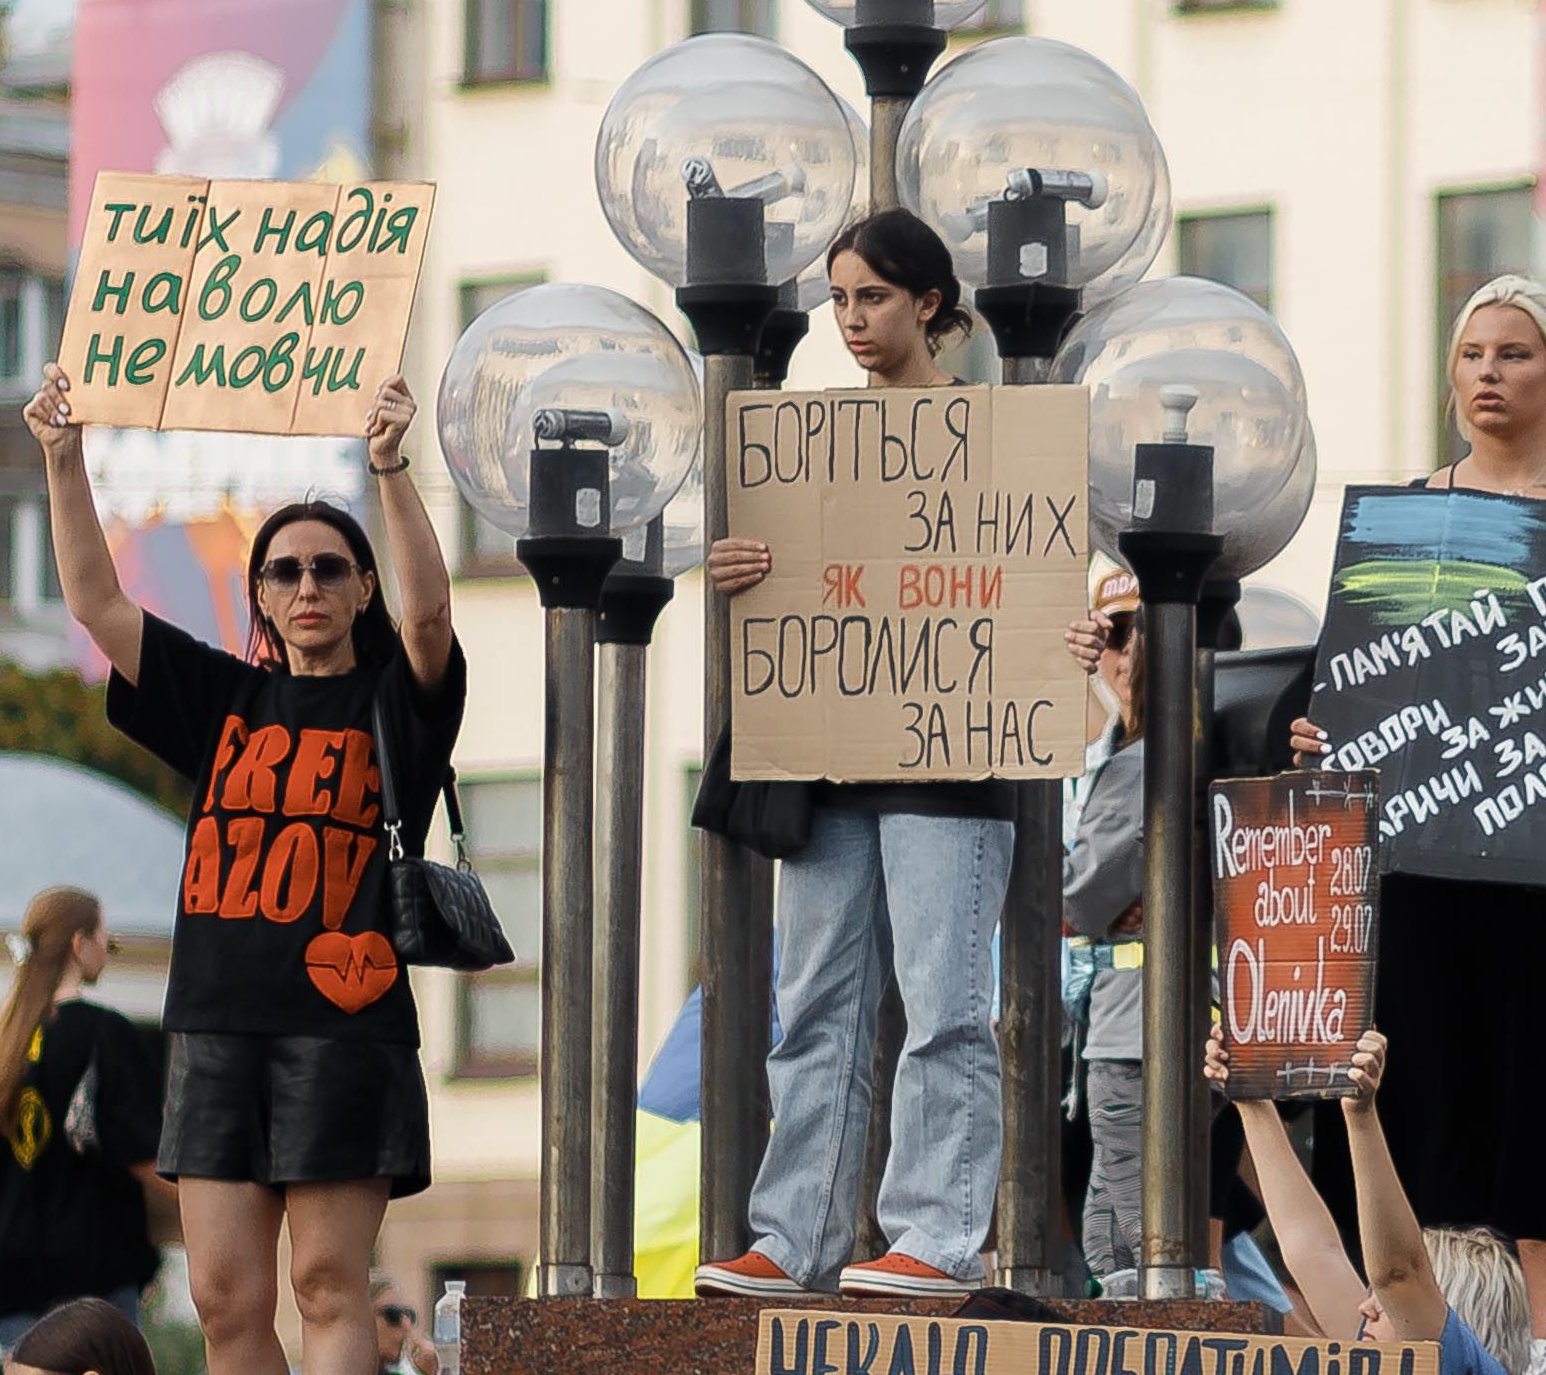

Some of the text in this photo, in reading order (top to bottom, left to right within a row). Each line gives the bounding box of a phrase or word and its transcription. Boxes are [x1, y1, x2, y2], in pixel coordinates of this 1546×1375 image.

[254, 187, 420, 255] надія
[92, 255, 365, 326] на волю
[174, 332, 366, 396] мовчи
[739, 397, 971, 488] БОРІТЬСЯ
[904, 490, 1077, 557] ЗА НИХ
[822, 563, 1003, 610] ЯК ВОНИ
[742, 615, 994, 698] БОРОЛИСЯ
[898, 700, 1054, 769] ЗА НАС
[1441, 717, 1490, 760] ЗА
[203, 714, 382, 827] FREE
[1213, 789, 1333, 879] Remember
[184, 815, 377, 931] AZOV
[1254, 866, 1317, 928] about
[1227, 936, 1346, 1044] Olenivka
